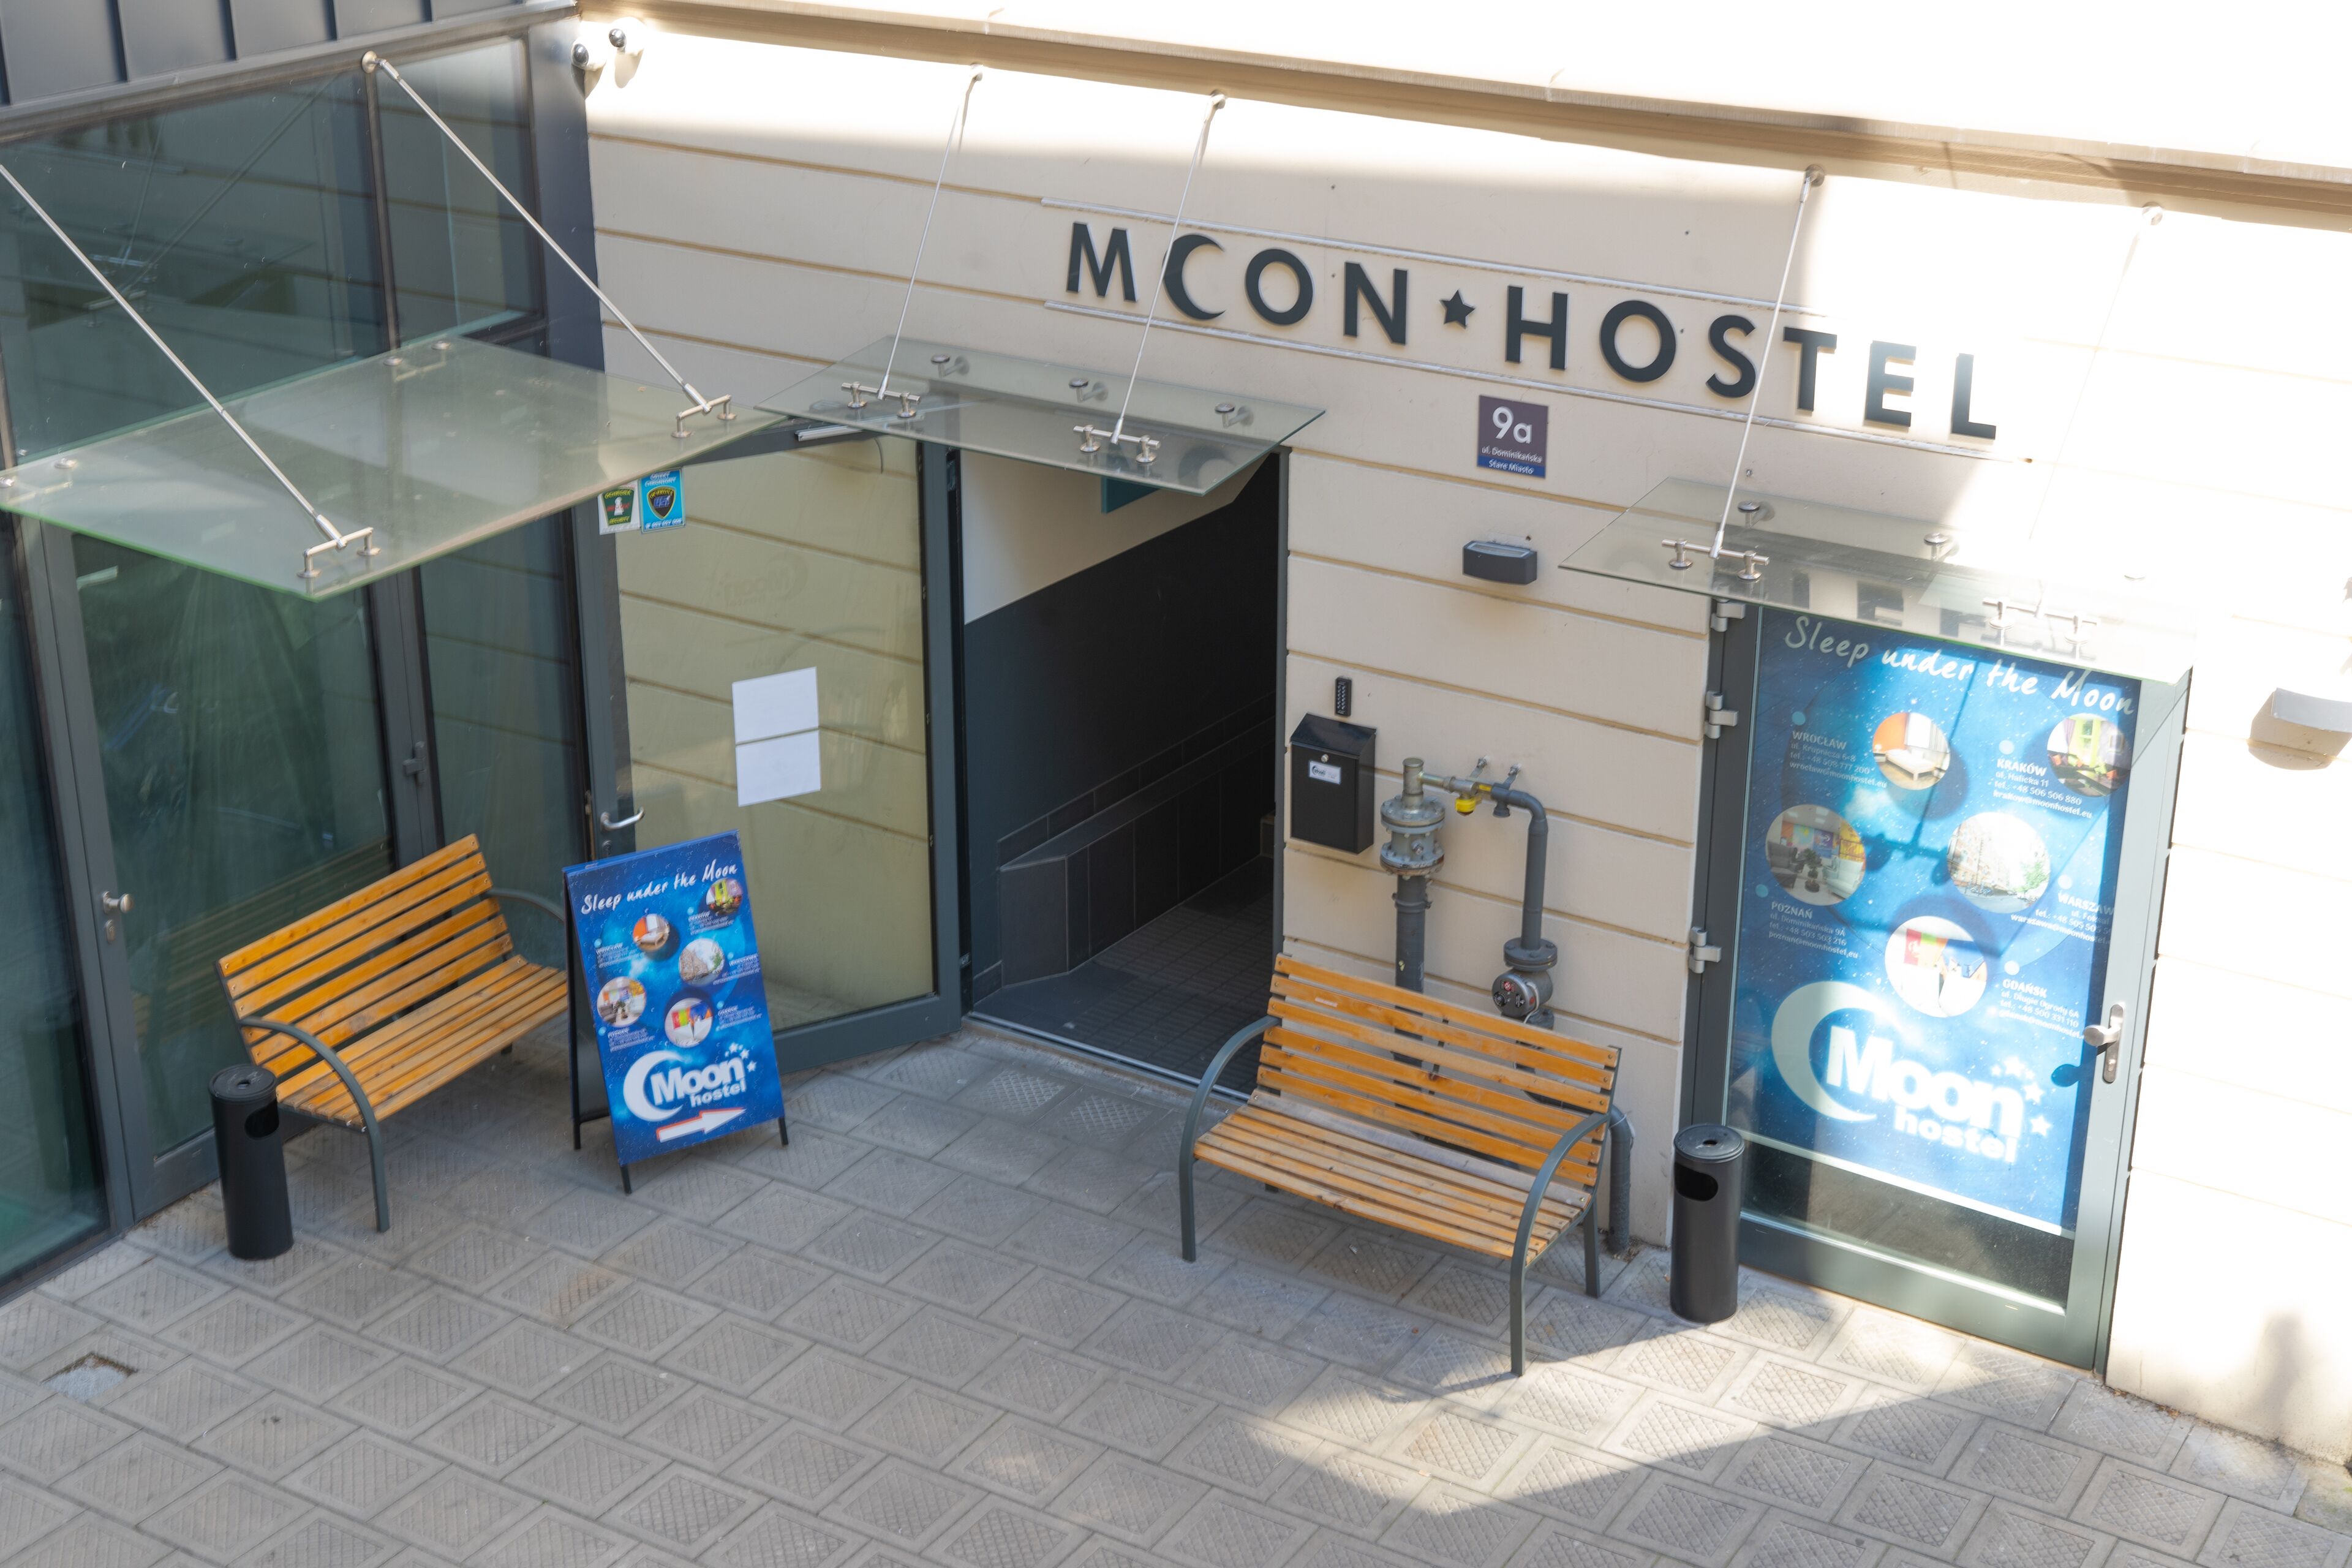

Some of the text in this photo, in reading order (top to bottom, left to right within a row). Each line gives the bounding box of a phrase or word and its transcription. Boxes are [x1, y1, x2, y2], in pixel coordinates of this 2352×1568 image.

[1505, 285, 1997, 440] HOSTEL
[1493, 406, 1532, 443] 9a
[1492, 447, 1542, 463] Dominikańska
[1489, 459, 1534, 474] Stare Miasto
[1785, 616, 2135, 715] Sleep under the Moon
[1792, 730, 1847, 750] WROCŁAW
[1803, 744, 1840, 758] Krupnicza
[1855, 766, 1870, 775] 200
[1997, 758, 2048, 777] KRAKÓW
[2008, 774, 2039, 785] Halicka
[2013, 784, 2029, 793] +48
[2030, 787, 2046, 797] 506
[2048, 791, 2064, 801] 506
[2065, 795, 2082, 805] 880
[581, 858, 737, 914] Sleep under the Moon
[1771, 901, 1813, 919] POZNAŃ
[2053, 914, 2067, 924] +48
[2069, 918, 2084, 929] 505
[1786, 925, 1799, 935] +48
[1800, 929, 1815, 939] 503
[1833, 937, 1847, 946] 216
[2002, 979, 2048, 998] GDAŃSK
[2040, 999, 2068, 1016] Ogrody
[2068, 1009, 2079, 1019] 6A
[2051, 1013, 2065, 1023] 331
[2067, 1017, 2079, 1028] 110
[650, 1057, 746, 1106] Moon
[1826, 1025, 2024, 1138] Moon
[690, 1077, 747, 1107] hostel
[1895, 1105, 2018, 1163] hostel
